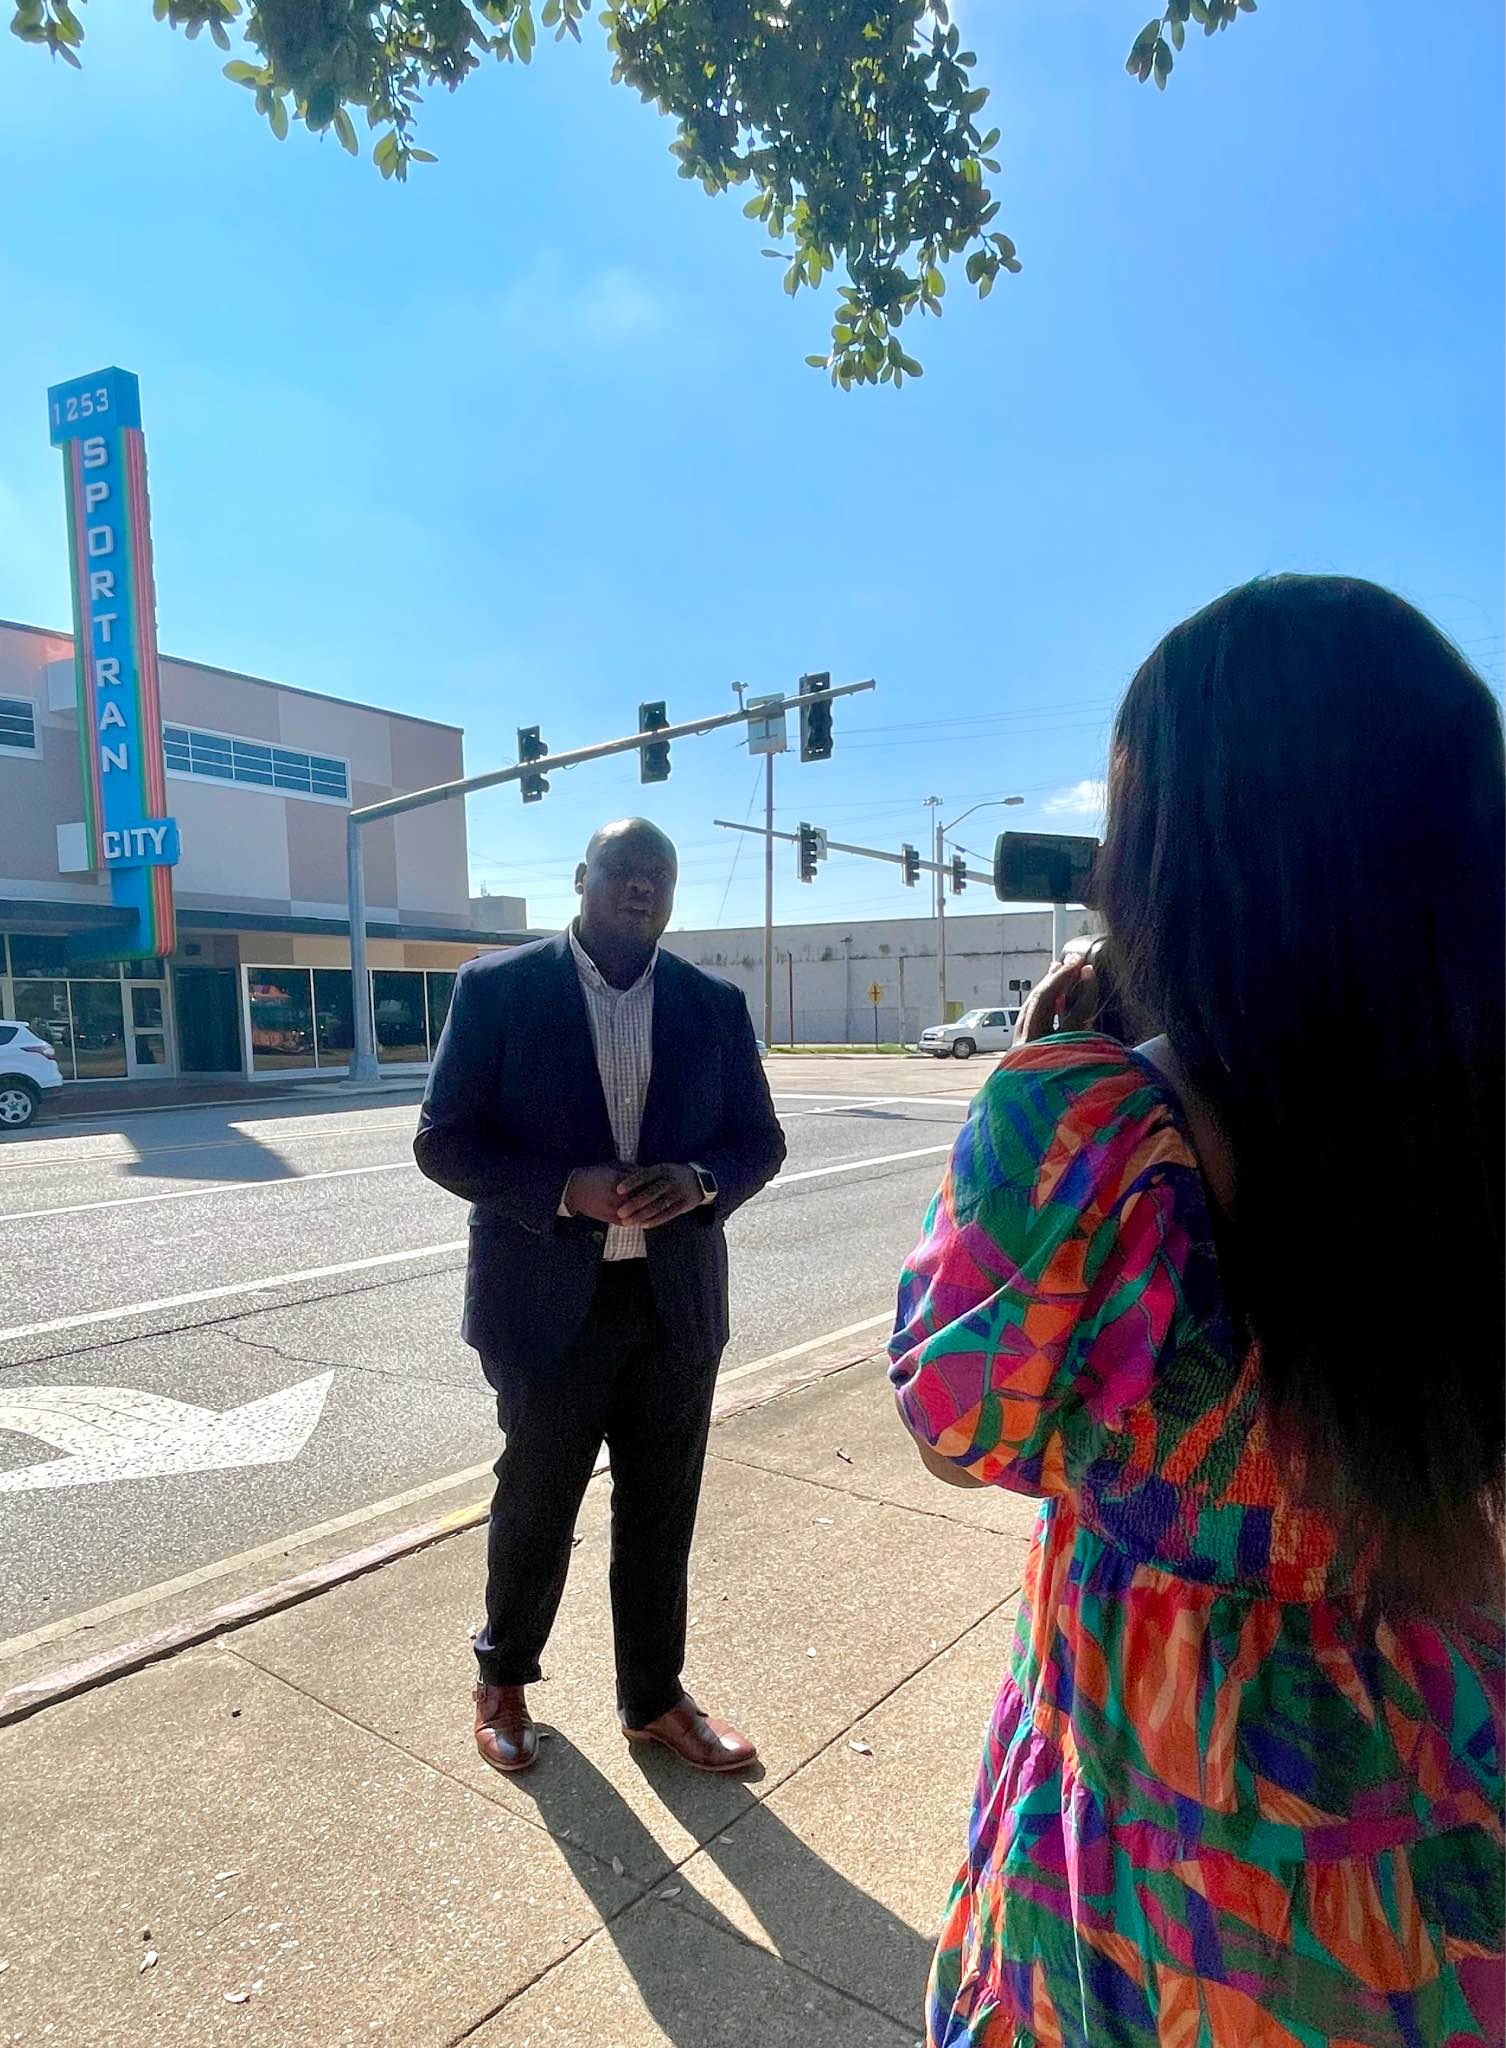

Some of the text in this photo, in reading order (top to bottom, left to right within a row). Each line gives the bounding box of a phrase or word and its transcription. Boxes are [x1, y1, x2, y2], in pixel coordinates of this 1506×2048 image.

[54, 388, 108, 424] 1253
[83, 436, 128, 772] SPORTRAN
[103, 826, 167, 858] CITY
